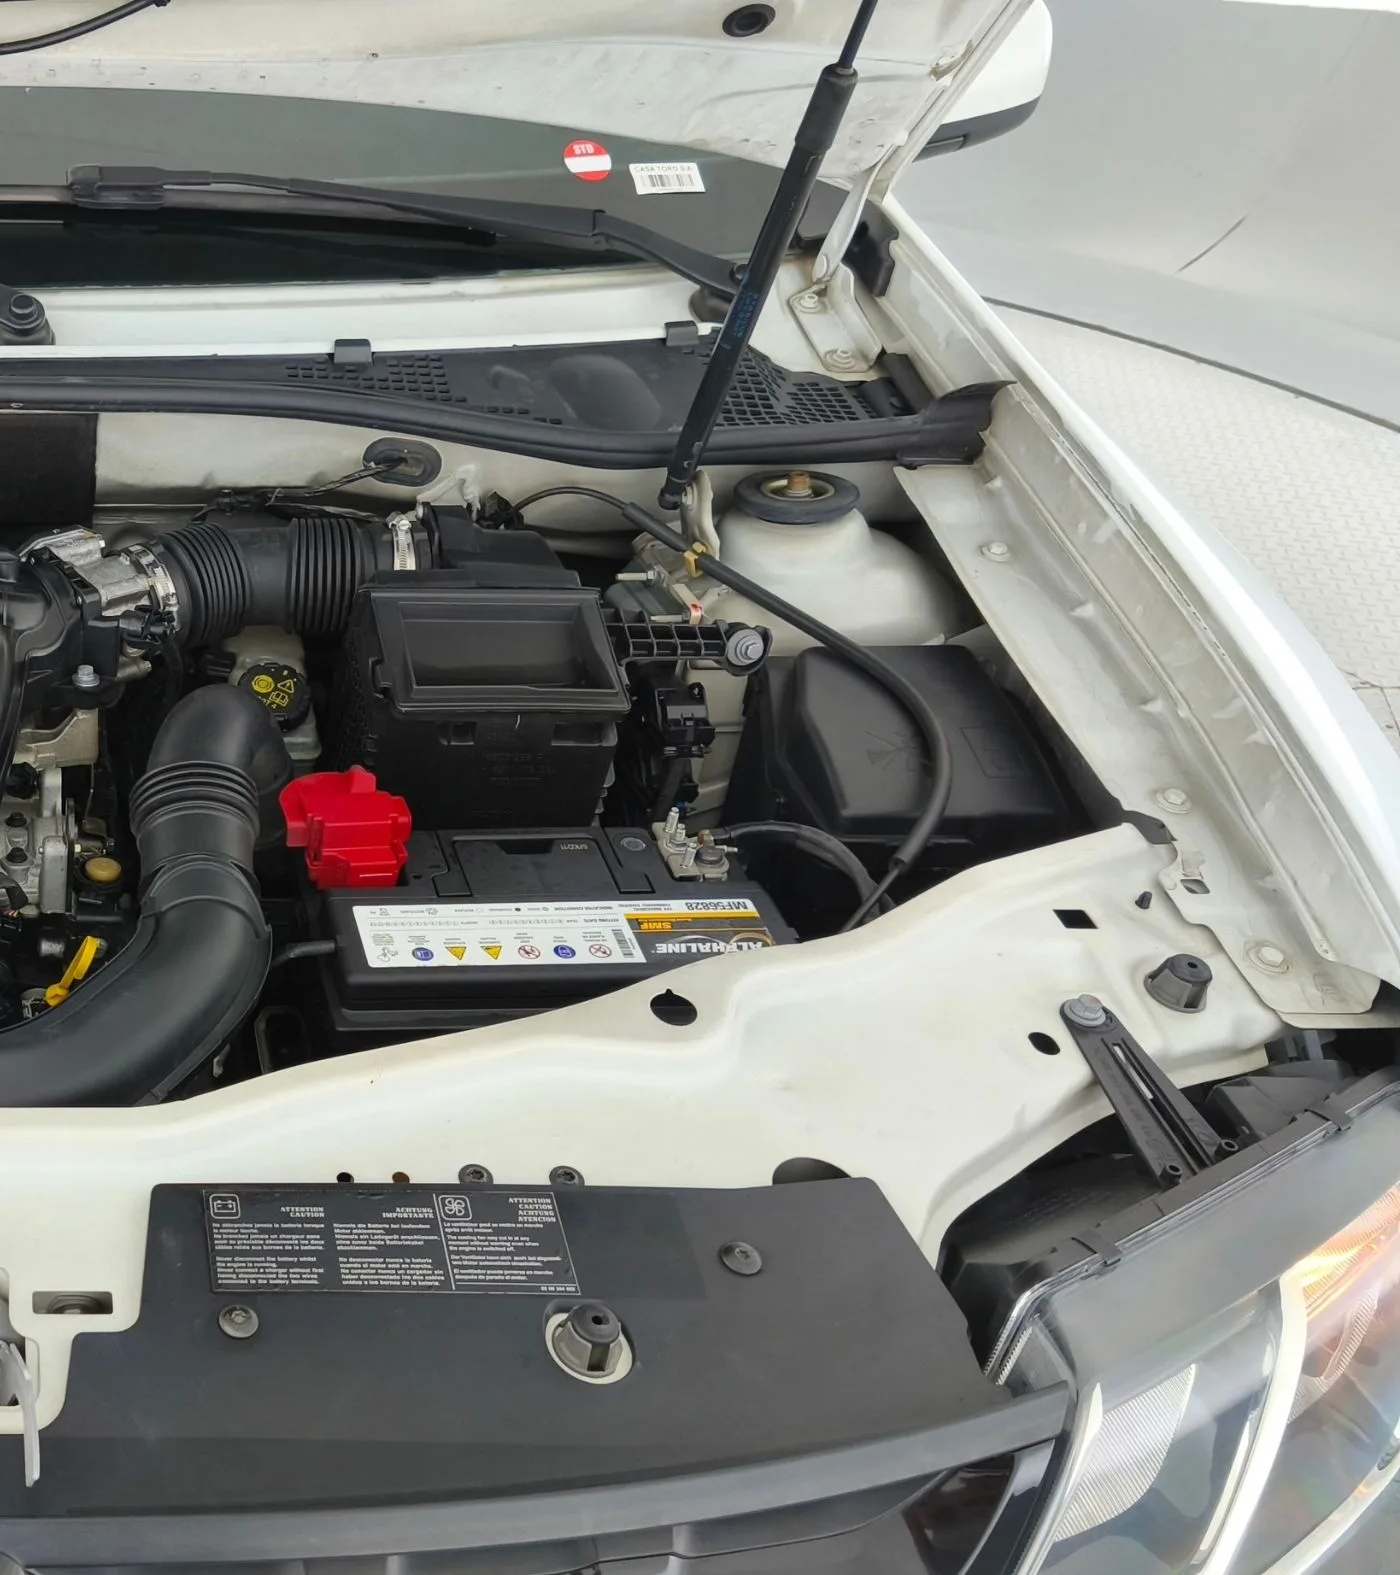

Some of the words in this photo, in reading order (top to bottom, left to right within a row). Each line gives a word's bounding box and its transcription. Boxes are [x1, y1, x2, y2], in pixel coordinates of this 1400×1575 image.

[572, 143, 595, 155] STD
[684, 900, 748, 911] MF56828
[639, 921, 672, 930] SMF
[655, 941, 763, 954] ALPHALINE
